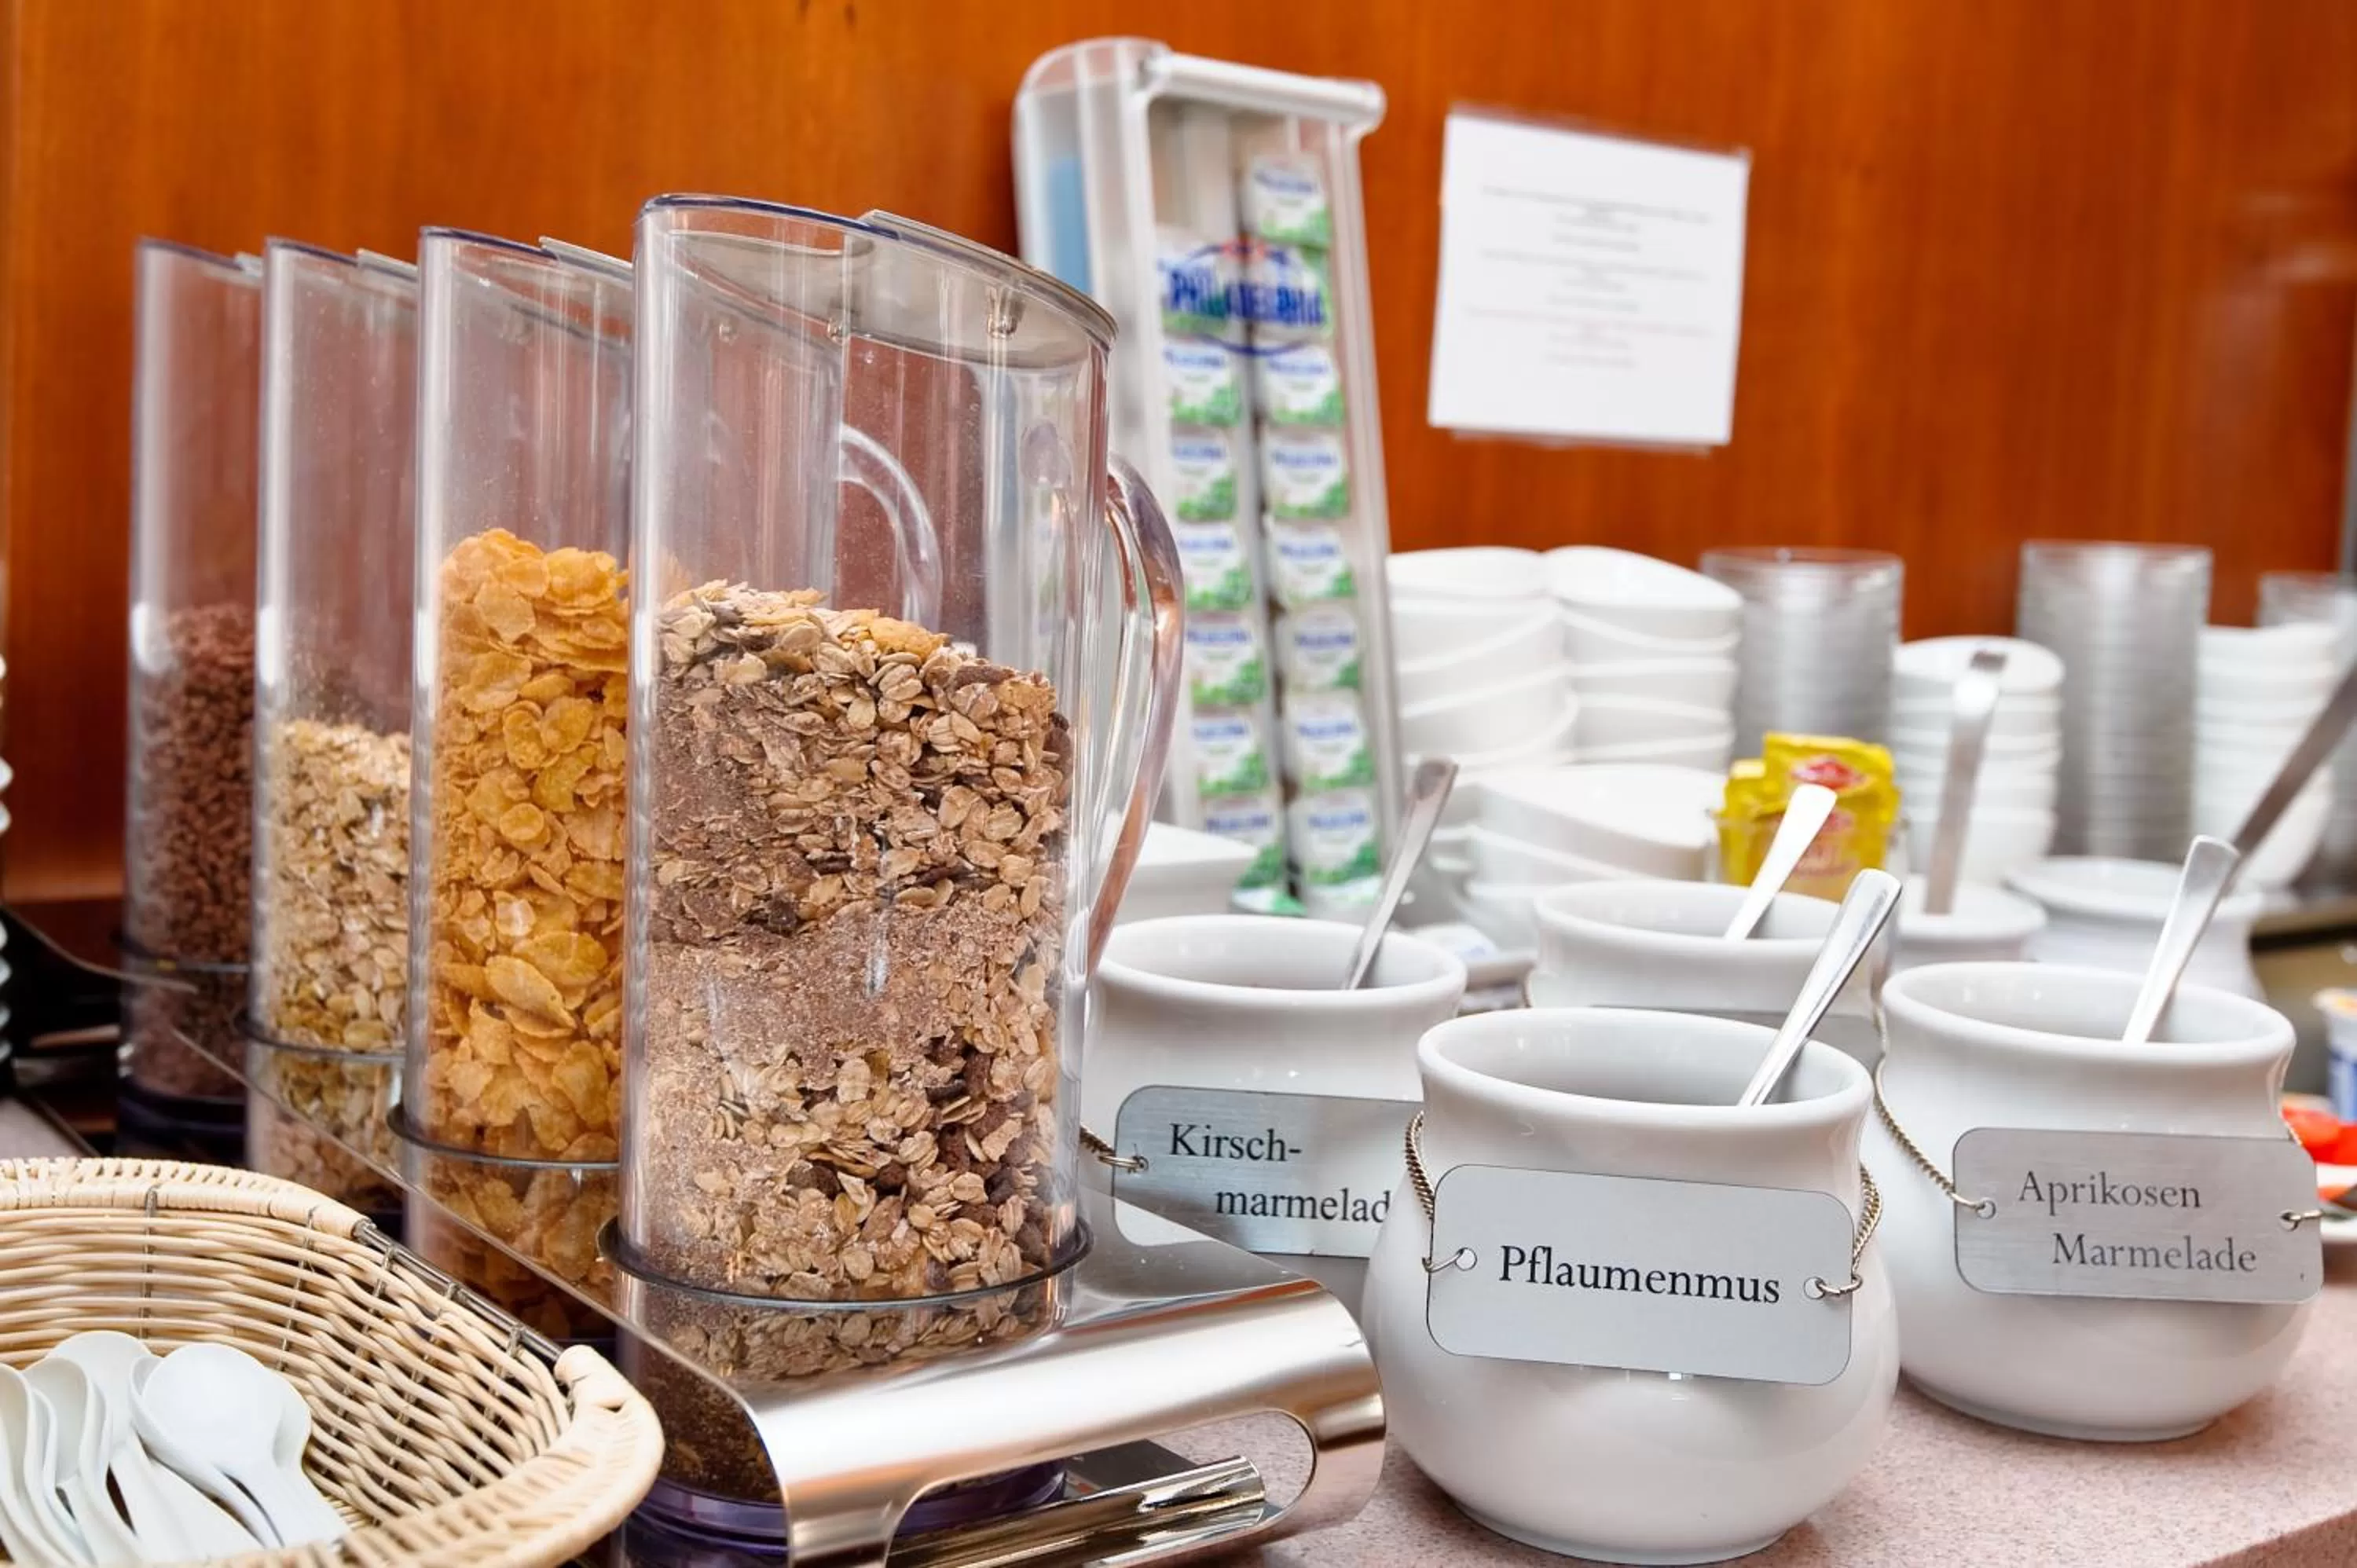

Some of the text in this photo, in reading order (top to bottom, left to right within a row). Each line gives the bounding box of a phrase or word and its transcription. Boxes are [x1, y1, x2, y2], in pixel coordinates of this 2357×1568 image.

[1169, 1123, 1302, 1162] Kirsch-
[1215, 1188, 1391, 1224] marmelad
[2019, 1171, 2201, 1217] Aprikosen
[2052, 1233, 2257, 1272] Marmelade
[1498, 1244, 1780, 1304] Pflaumenmus
